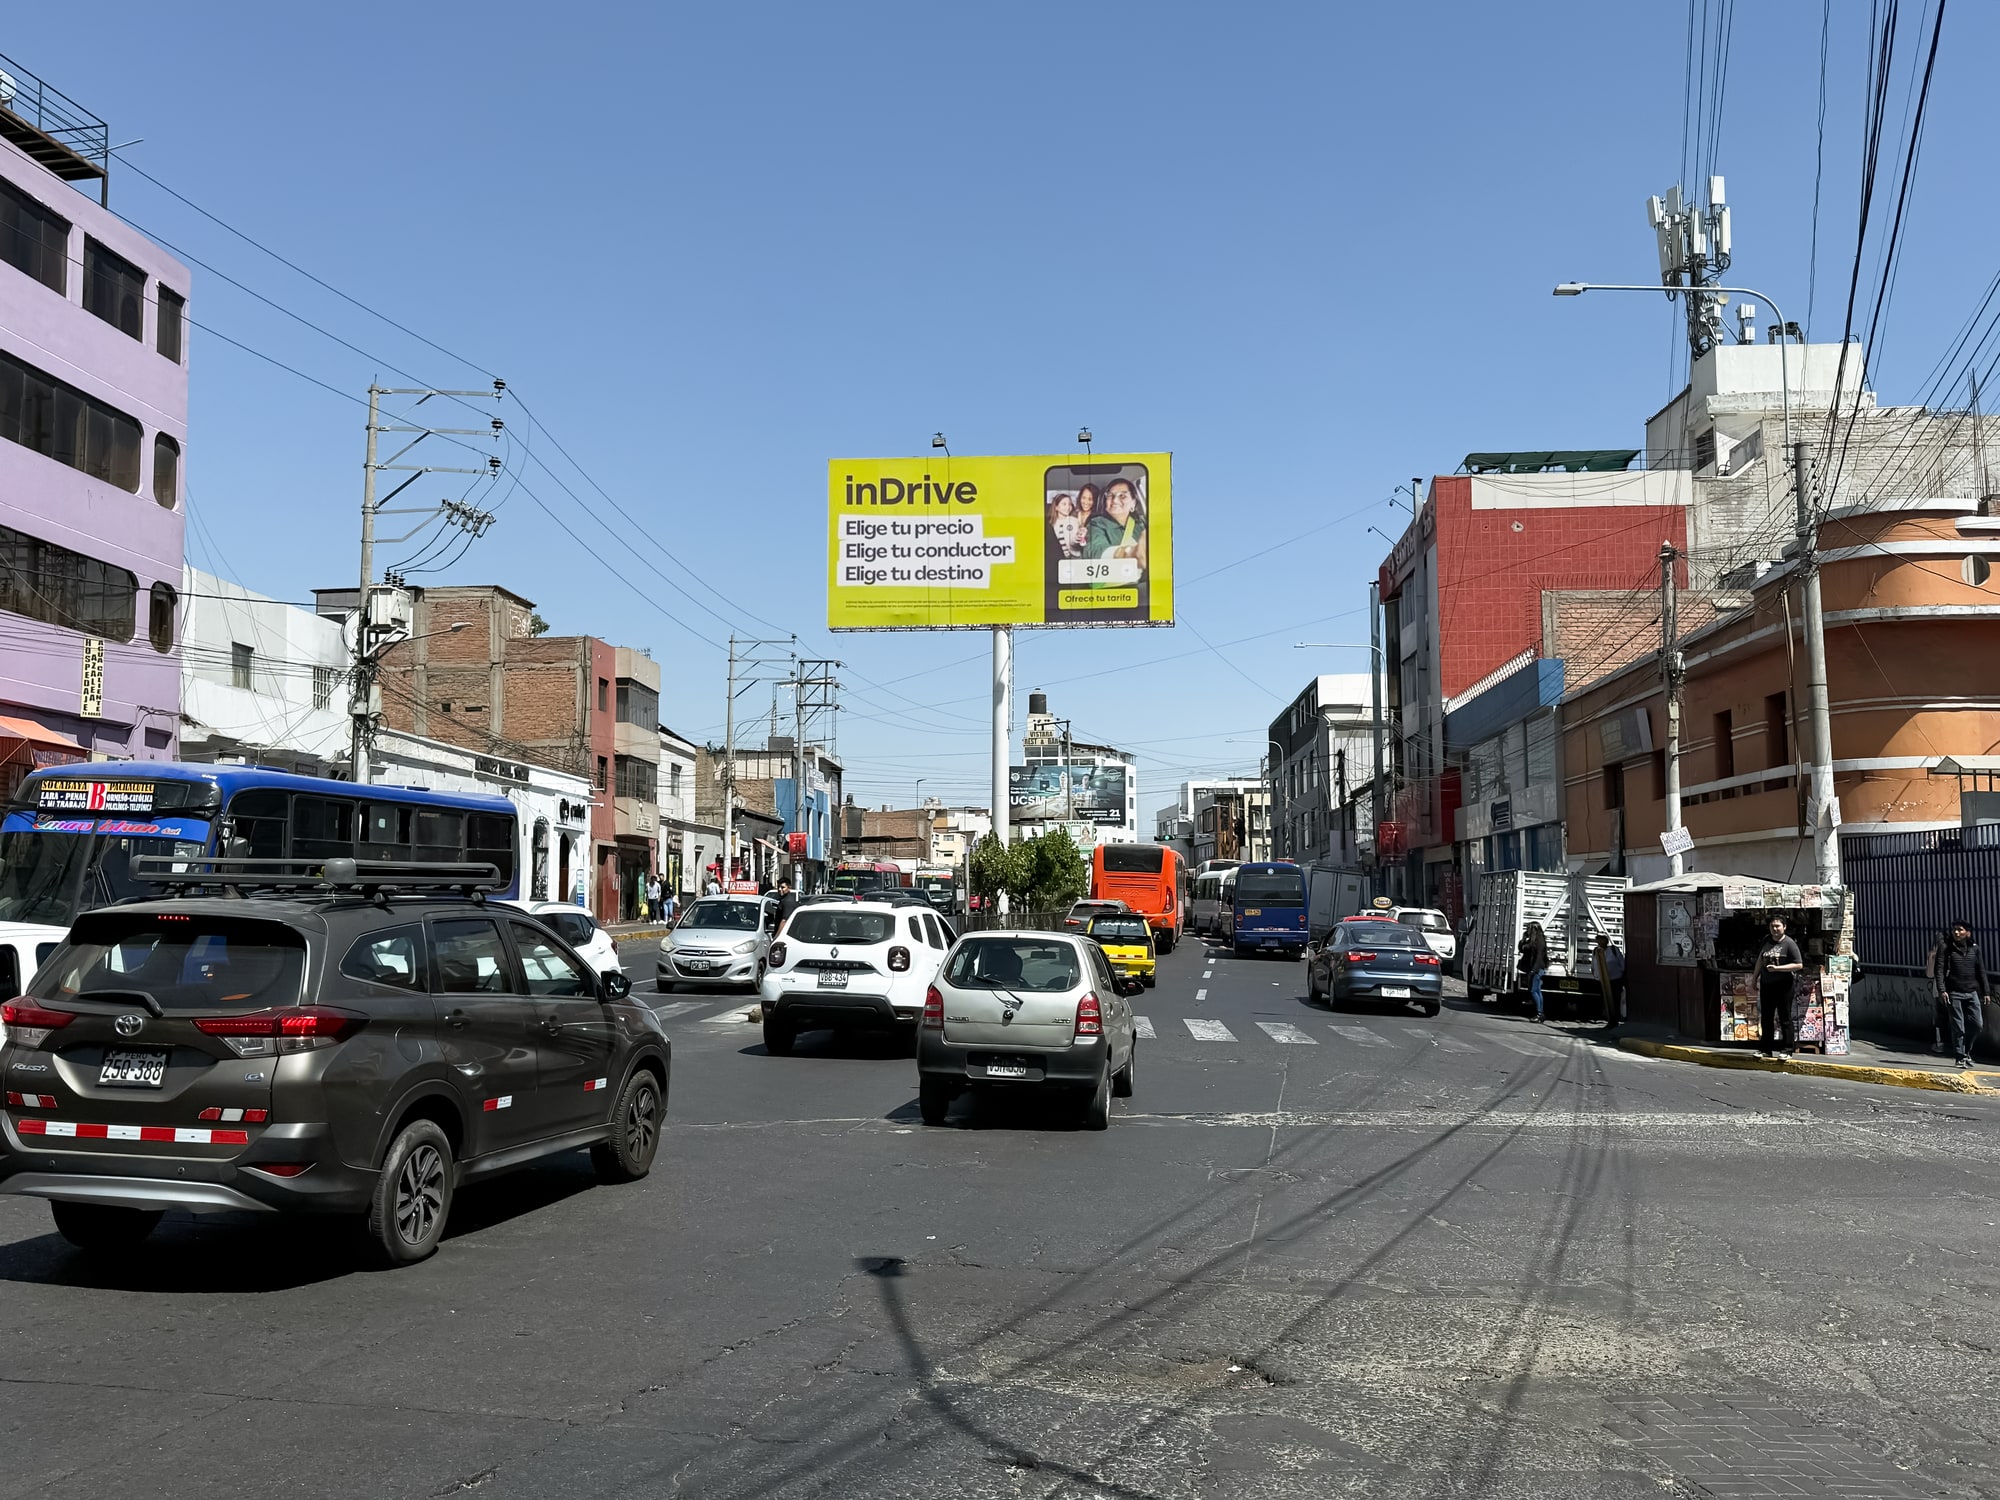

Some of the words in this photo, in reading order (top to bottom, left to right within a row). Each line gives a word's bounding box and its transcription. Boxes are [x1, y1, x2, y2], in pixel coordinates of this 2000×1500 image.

[846, 475, 977, 505] inDrive
[846, 520, 887, 539] Elige
[891, 521, 911, 535] tu
[915, 519, 973, 538] precio
[846, 543, 887, 562] Elige
[891, 544, 911, 558] tu
[915, 542, 1012, 558] conductor
[846, 566, 887, 585] Elige
[890, 567, 911, 581] tu
[914, 565, 984, 581] destino
[1086, 564, 1109, 578] S/8
[1065, 595, 1094, 603] Ofrece
[1107, 594, 1131, 602] tarifa
[83, 639, 91, 711] HOSPEDAJE
[89, 654, 97, 701] AZALEA
[95, 665, 103, 712] CALIENTE
[57, 801, 86, 809] TRABAJO
[65, 793, 86, 801] PENAL
[92, 783, 105, 809] B
[1010, 796, 1046, 805] UCSM
[1109, 809, 1120, 817] 21
